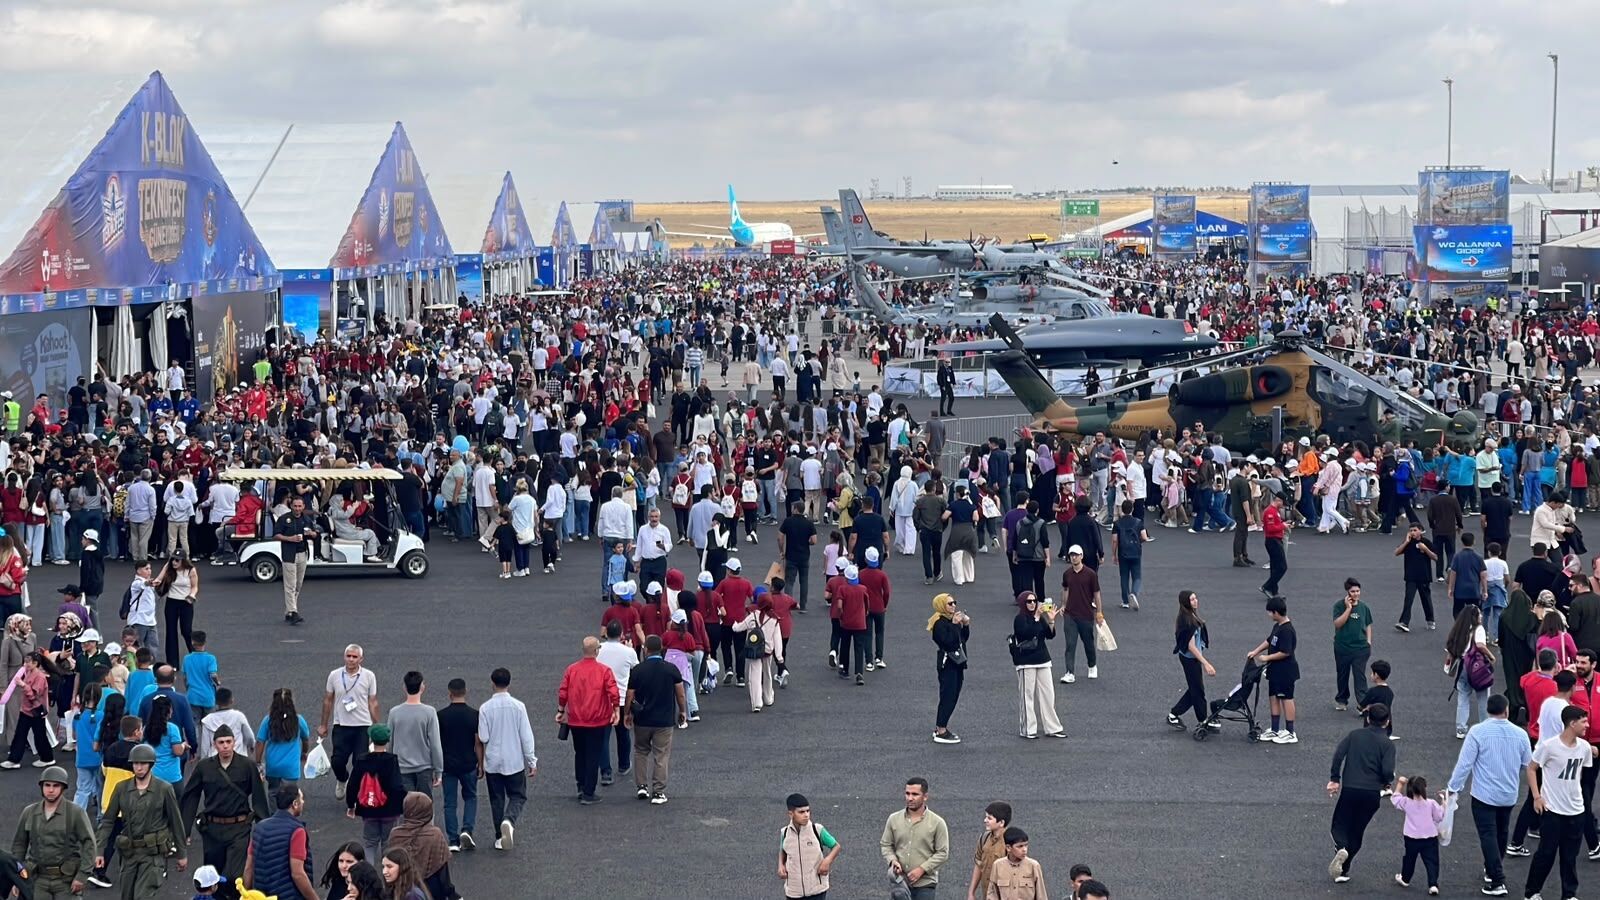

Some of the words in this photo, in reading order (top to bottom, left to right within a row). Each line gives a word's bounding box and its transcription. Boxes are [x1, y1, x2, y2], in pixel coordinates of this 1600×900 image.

[141, 111, 186, 166] K-BLOK
[138, 179, 187, 221] TEKNOFEST
[1450, 180, 1495, 196] TEKNOFEST
[40, 329, 72, 354] Kahoot!
